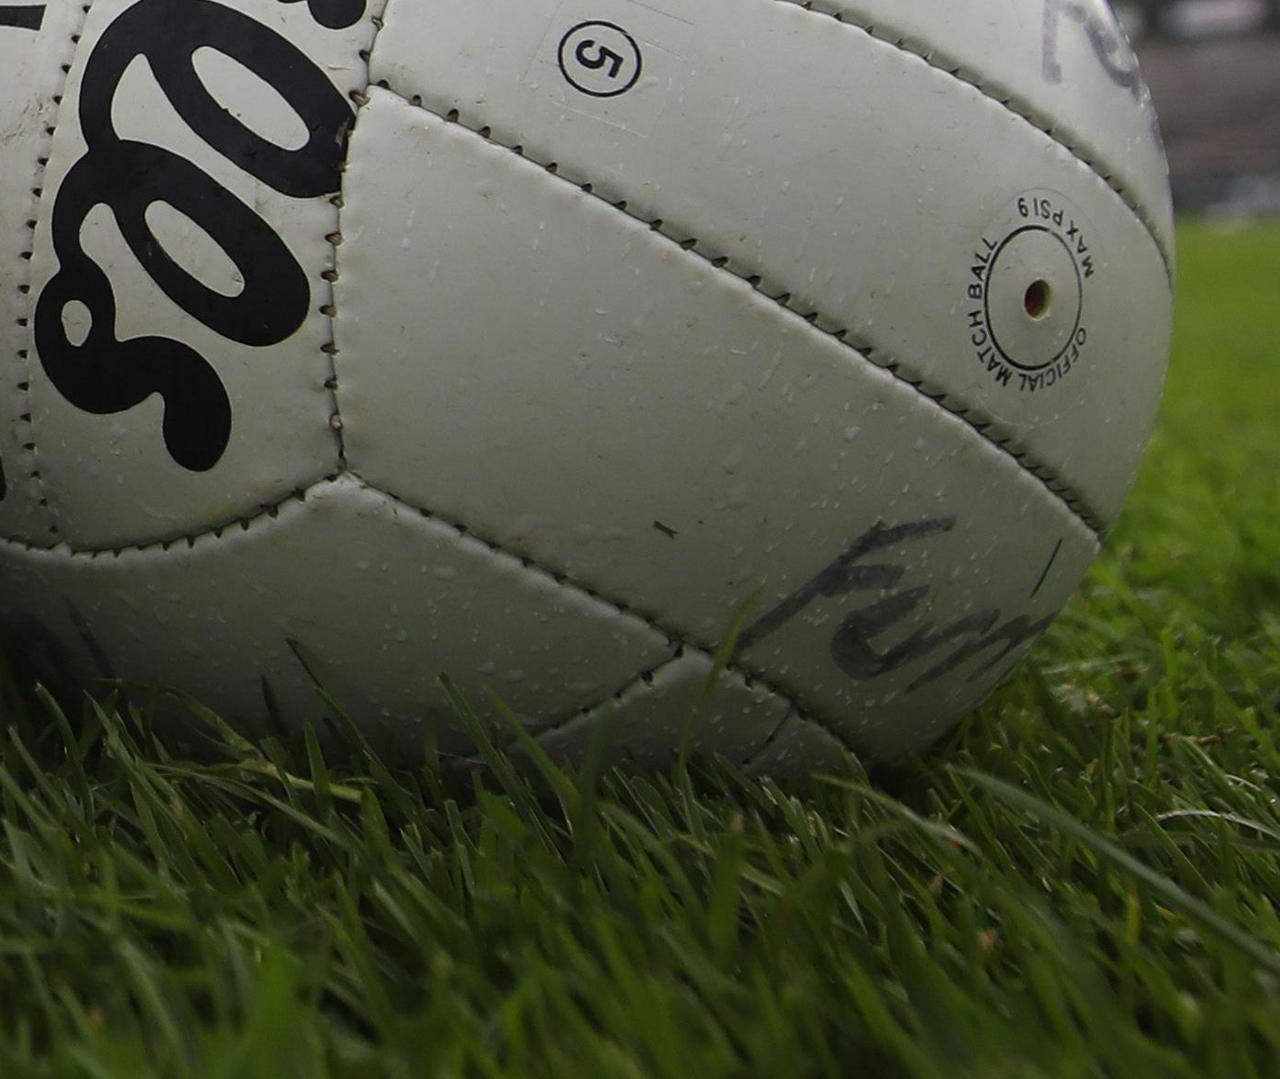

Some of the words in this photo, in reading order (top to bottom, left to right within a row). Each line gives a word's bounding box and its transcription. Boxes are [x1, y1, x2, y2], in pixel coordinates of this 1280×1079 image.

[1033, 198, 1064, 226] PSI
[968, 237, 998, 300] BALL
[1065, 219, 1096, 279] MAX
[968, 310, 1014, 387] MATCH
[1019, 327, 1087, 393] OFFICIAL
